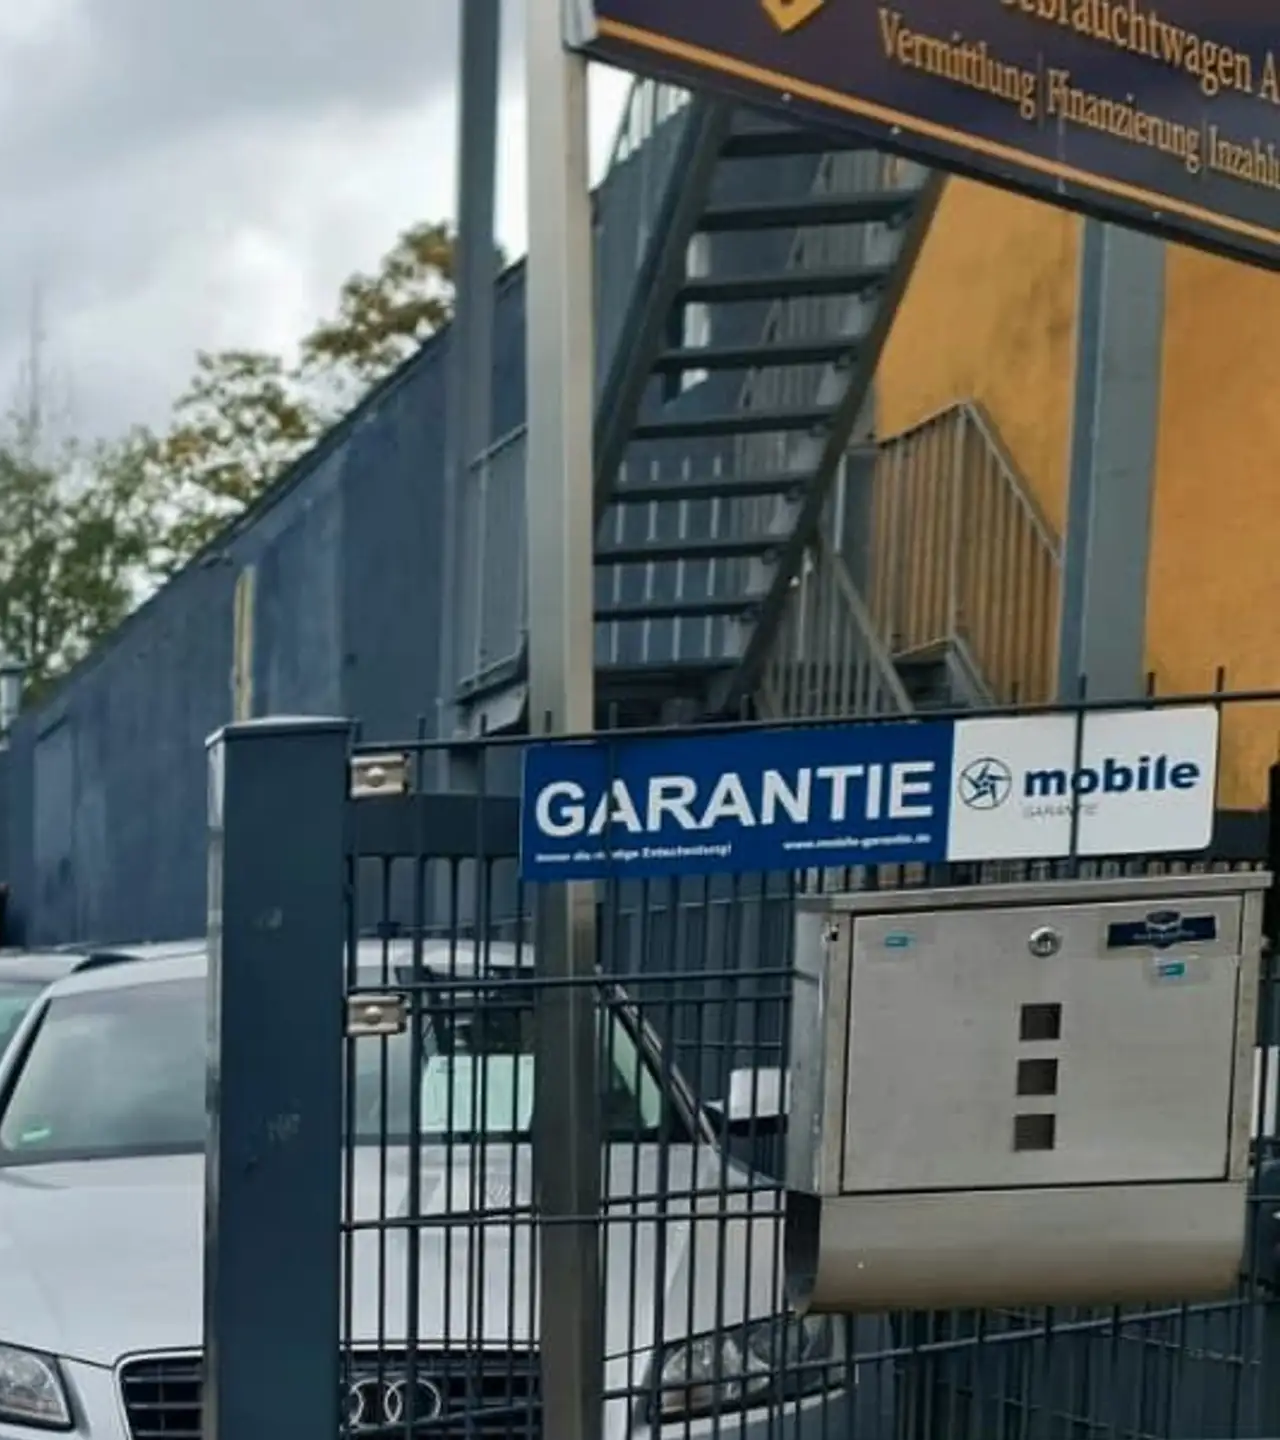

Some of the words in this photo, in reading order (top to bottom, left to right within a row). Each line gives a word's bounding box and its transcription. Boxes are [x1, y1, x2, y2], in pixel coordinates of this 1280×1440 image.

[878, 7, 1038, 120] Vermittlung
[1047, 68, 1200, 174] Finanzierung
[535, 760, 934, 837] GARANTIE
[1024, 754, 1200, 797] mobile
